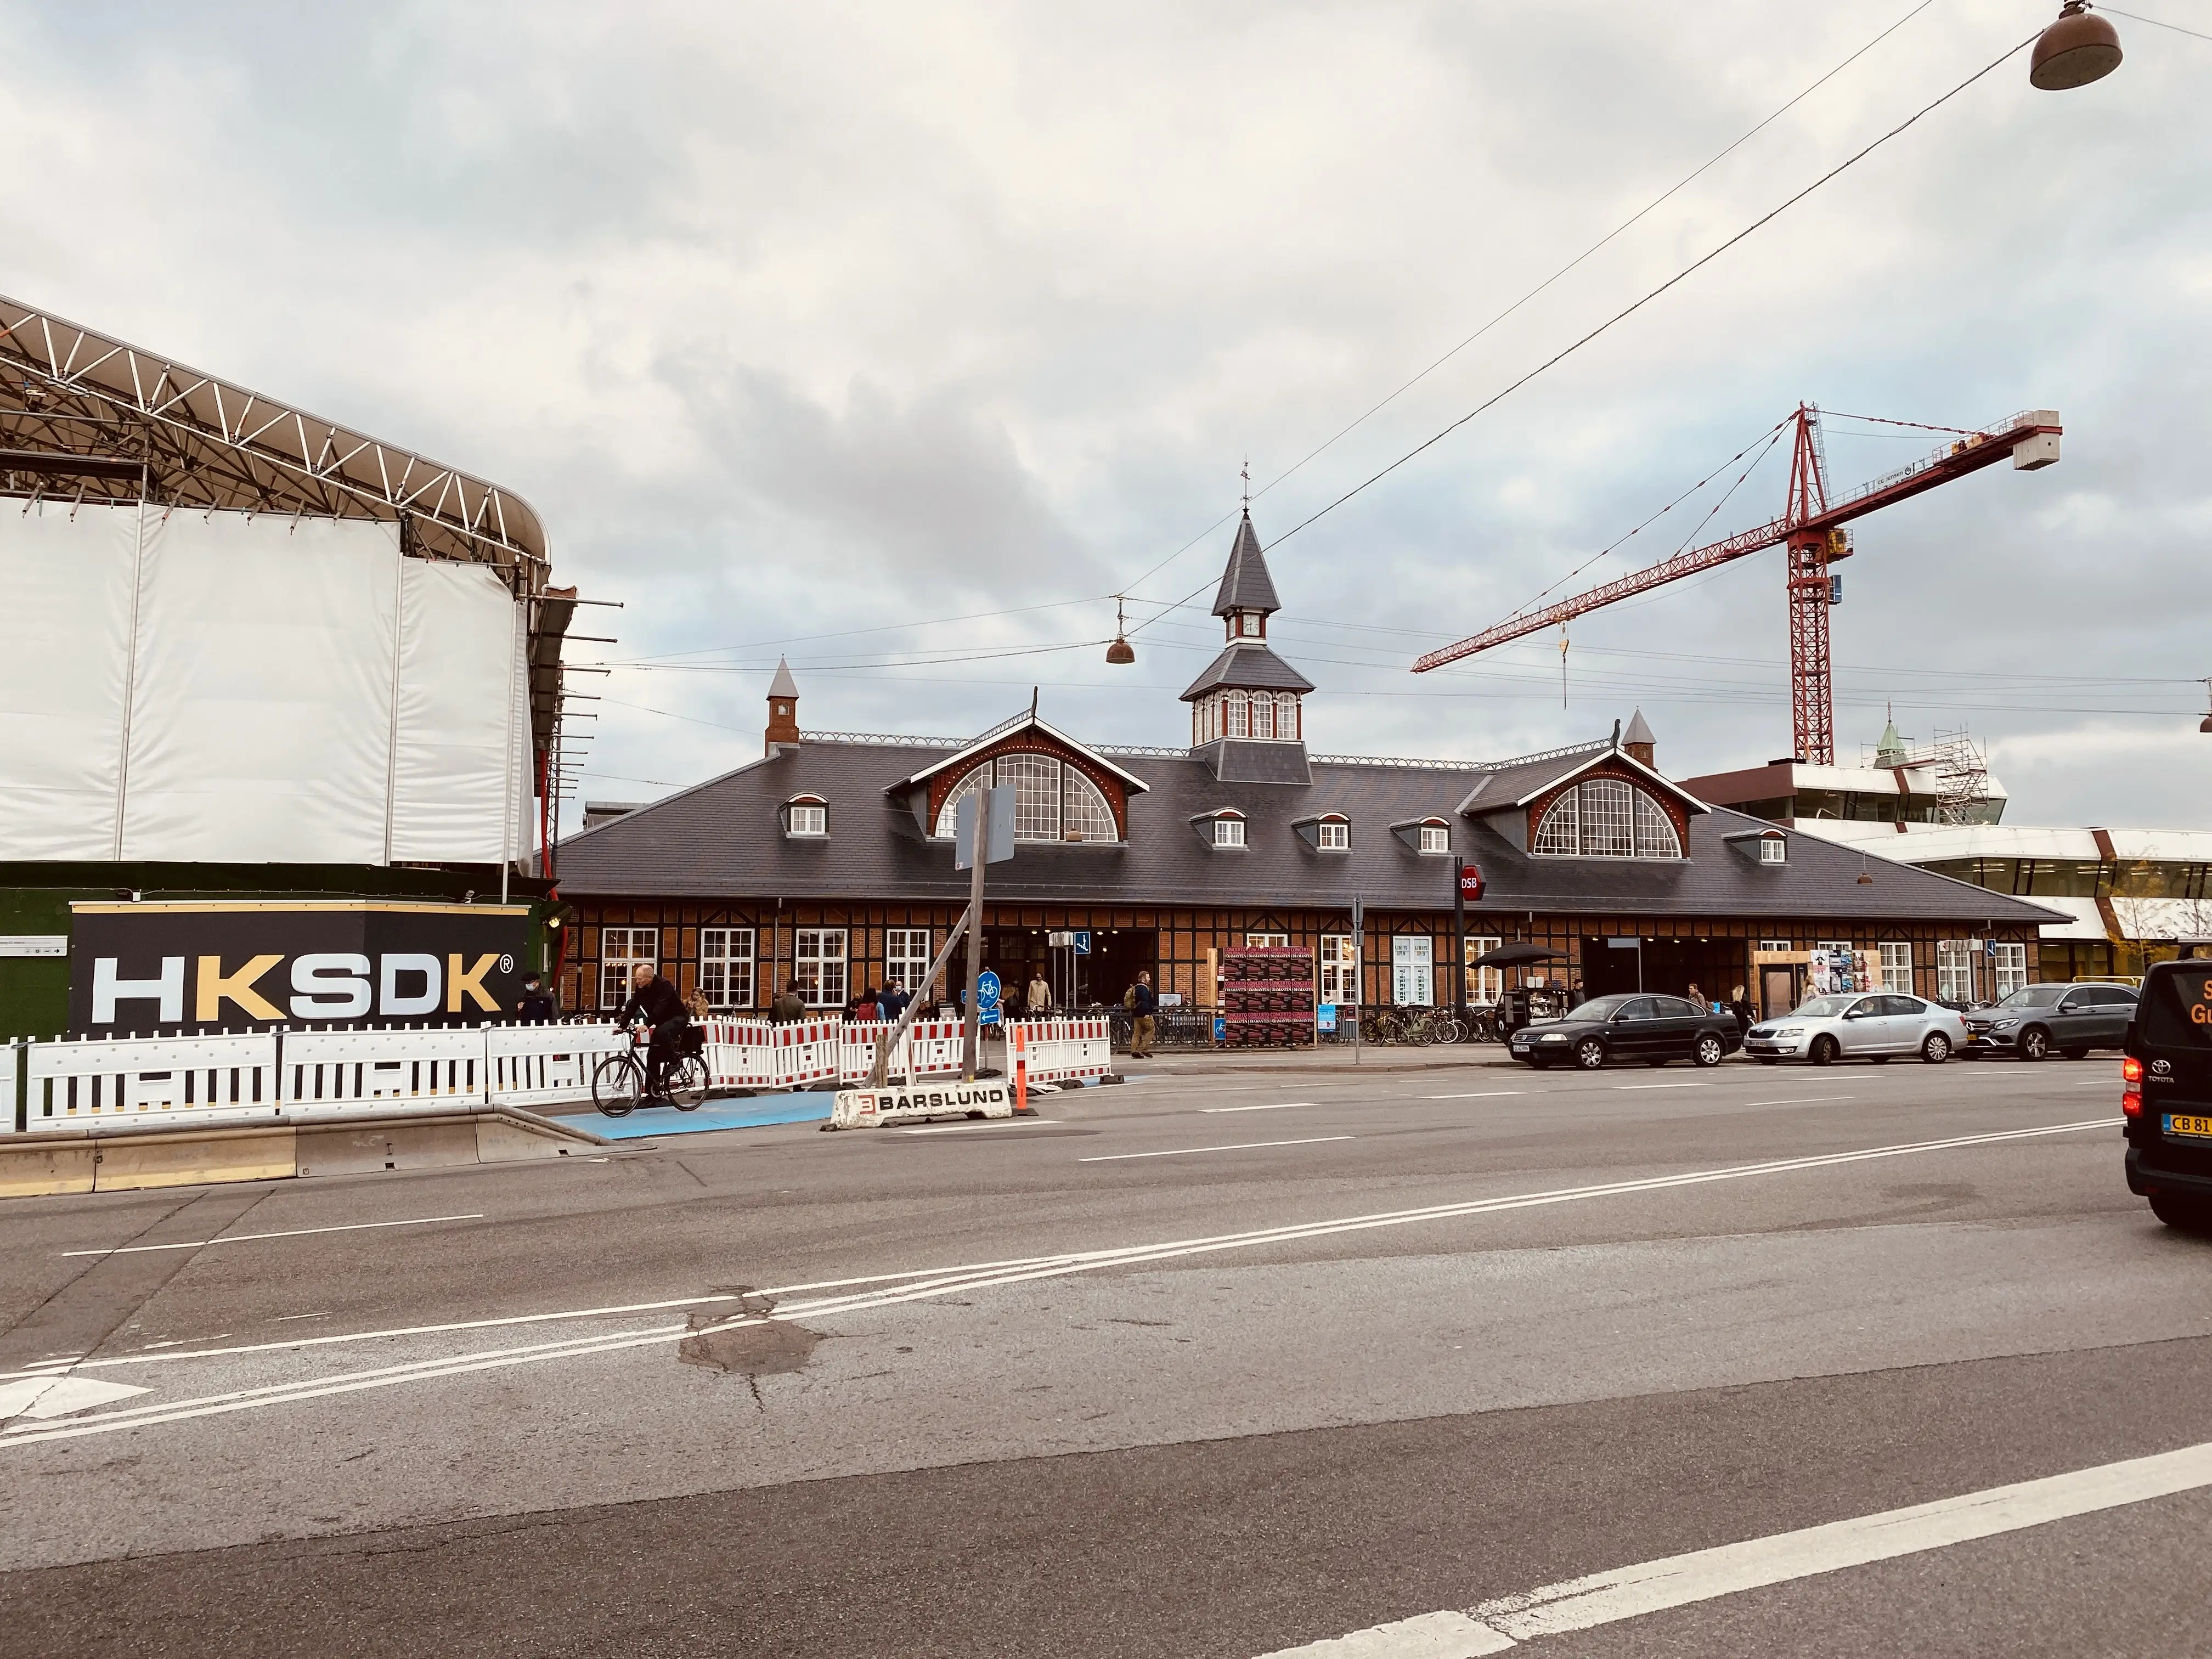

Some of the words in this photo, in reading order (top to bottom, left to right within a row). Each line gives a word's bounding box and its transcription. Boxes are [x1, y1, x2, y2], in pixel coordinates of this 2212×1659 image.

[1462, 878, 1477, 888] DSB
[879, 1090, 1003, 1110] BARSLUND
[2173, 1118, 2190, 1130] CB
[2194, 1119, 2210, 1132] 81
